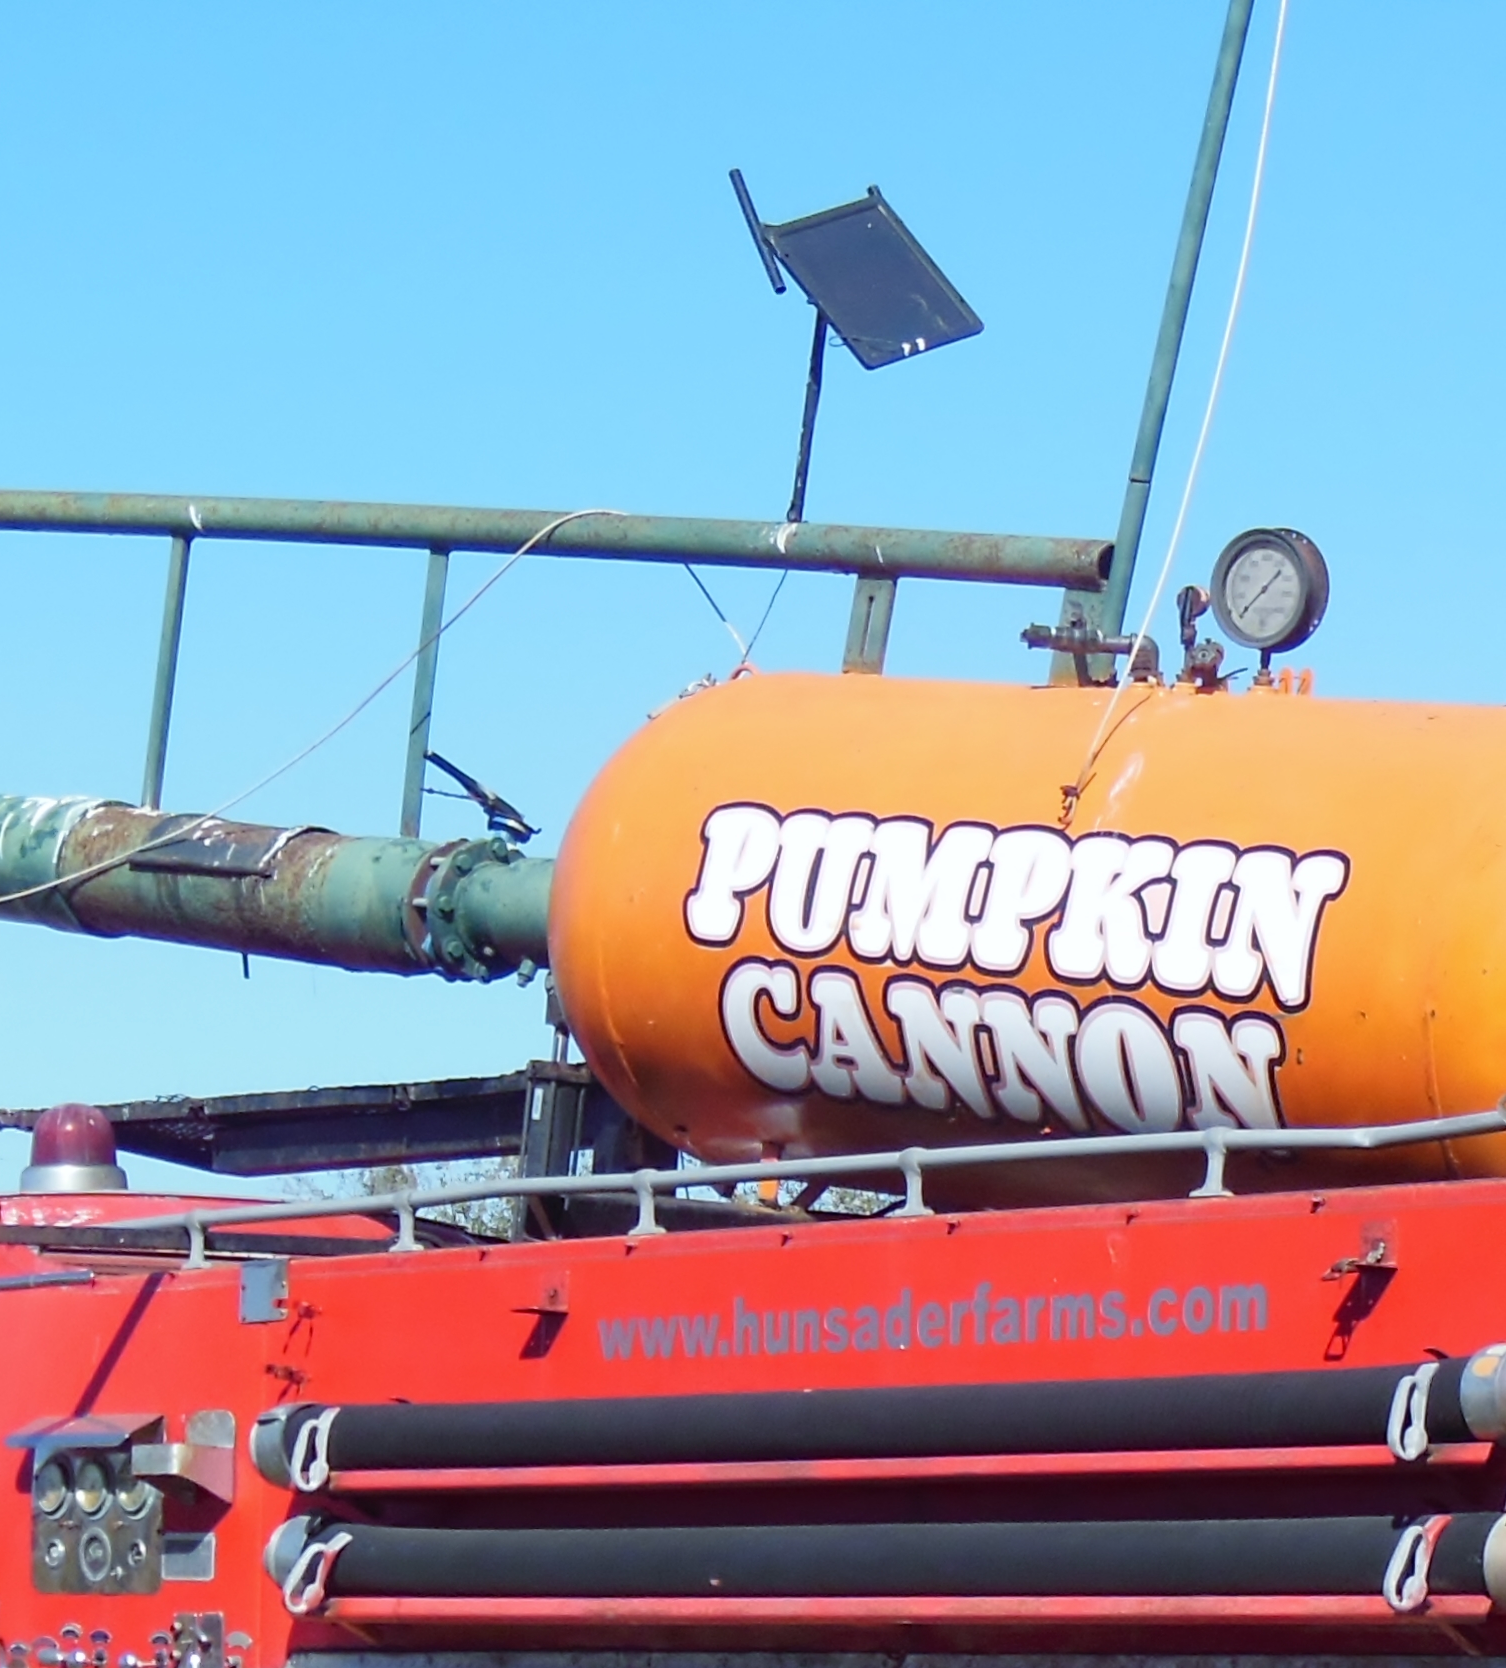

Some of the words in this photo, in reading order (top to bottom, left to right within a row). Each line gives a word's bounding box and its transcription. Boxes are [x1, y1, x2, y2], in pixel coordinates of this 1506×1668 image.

[683, 801, 1350, 1012] PUMPKIN
[719, 956, 1288, 1136] CANNON
[597, 1282, 1269, 1362] www.hunsaderfarms.com
